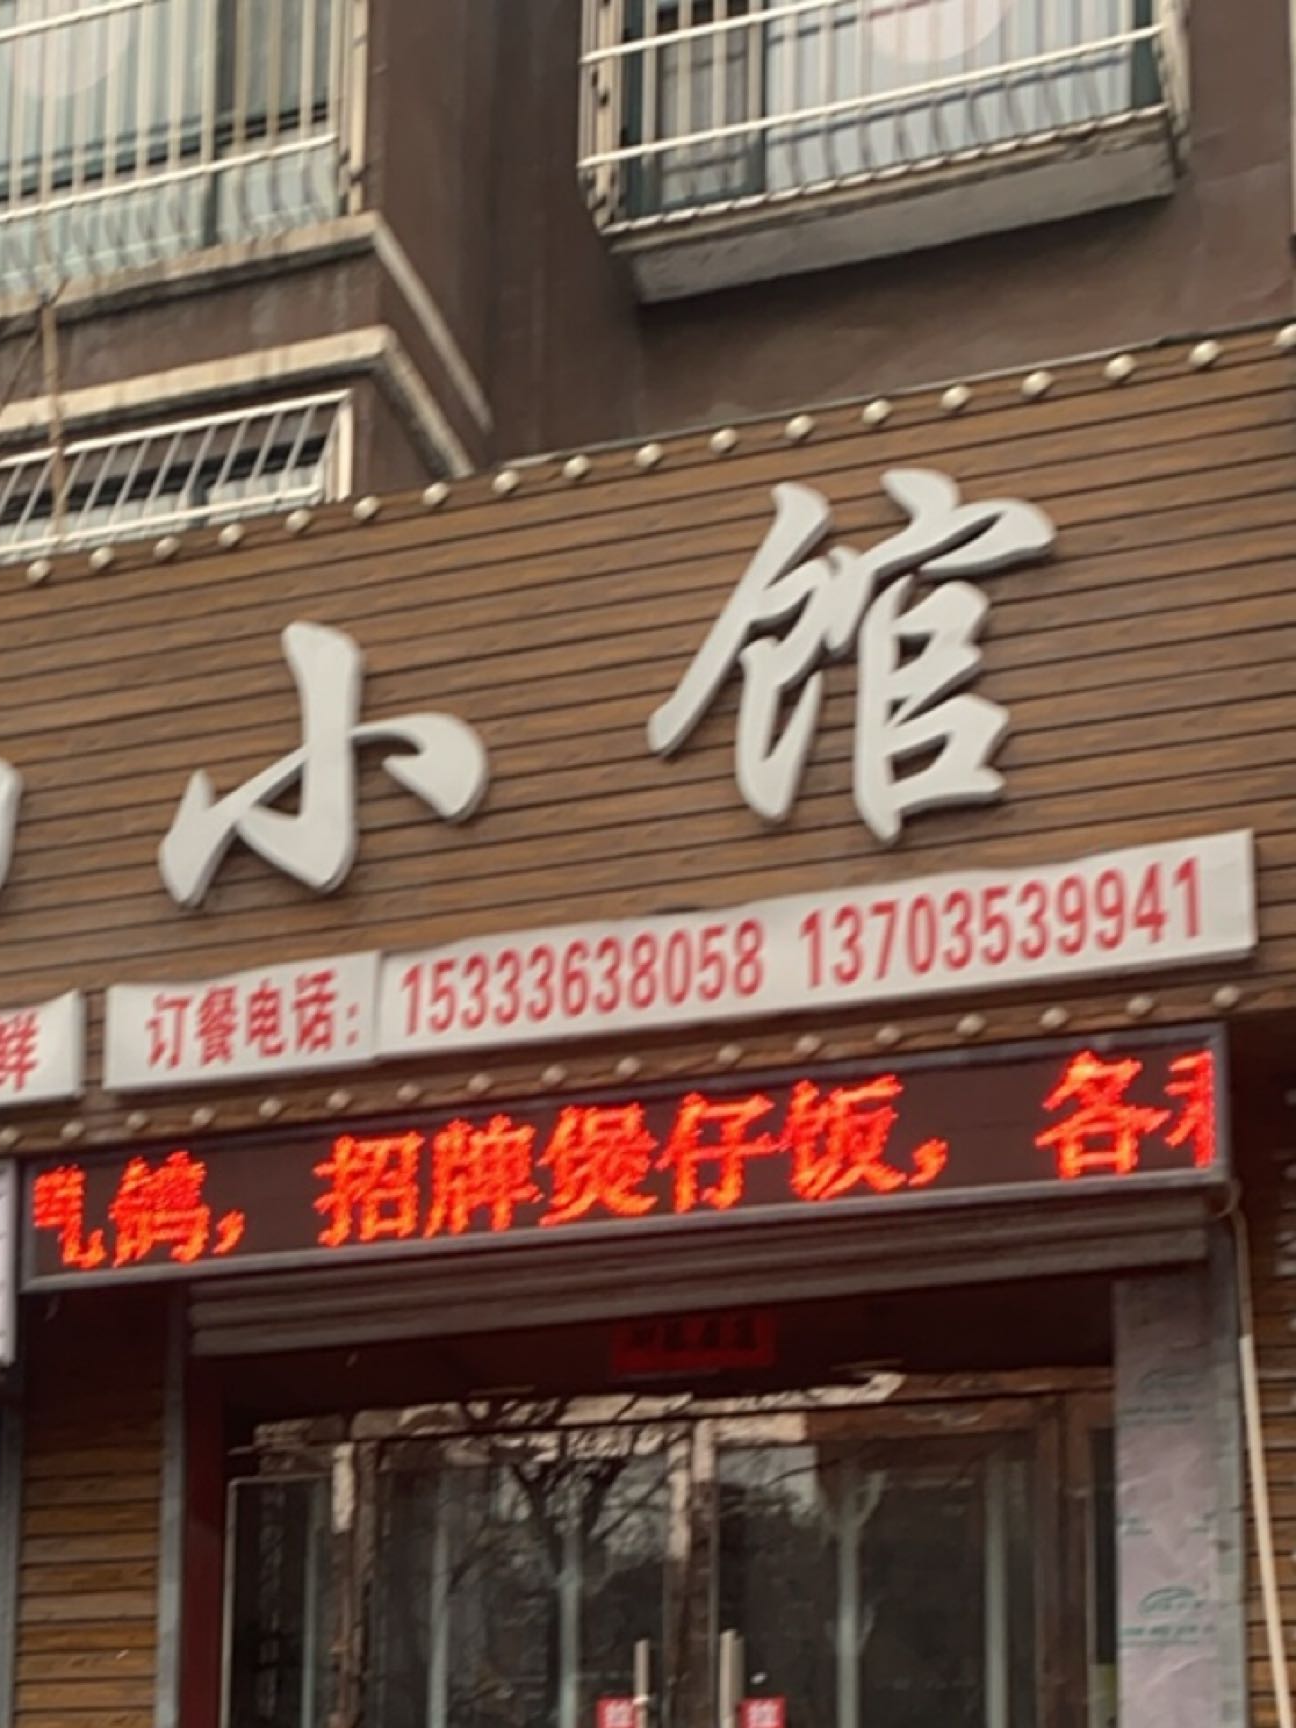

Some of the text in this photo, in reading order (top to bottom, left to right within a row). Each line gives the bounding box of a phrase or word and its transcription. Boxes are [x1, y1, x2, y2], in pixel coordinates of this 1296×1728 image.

[145, 857, 1202, 1069] 订餐电话： 15333638058 13703539941
